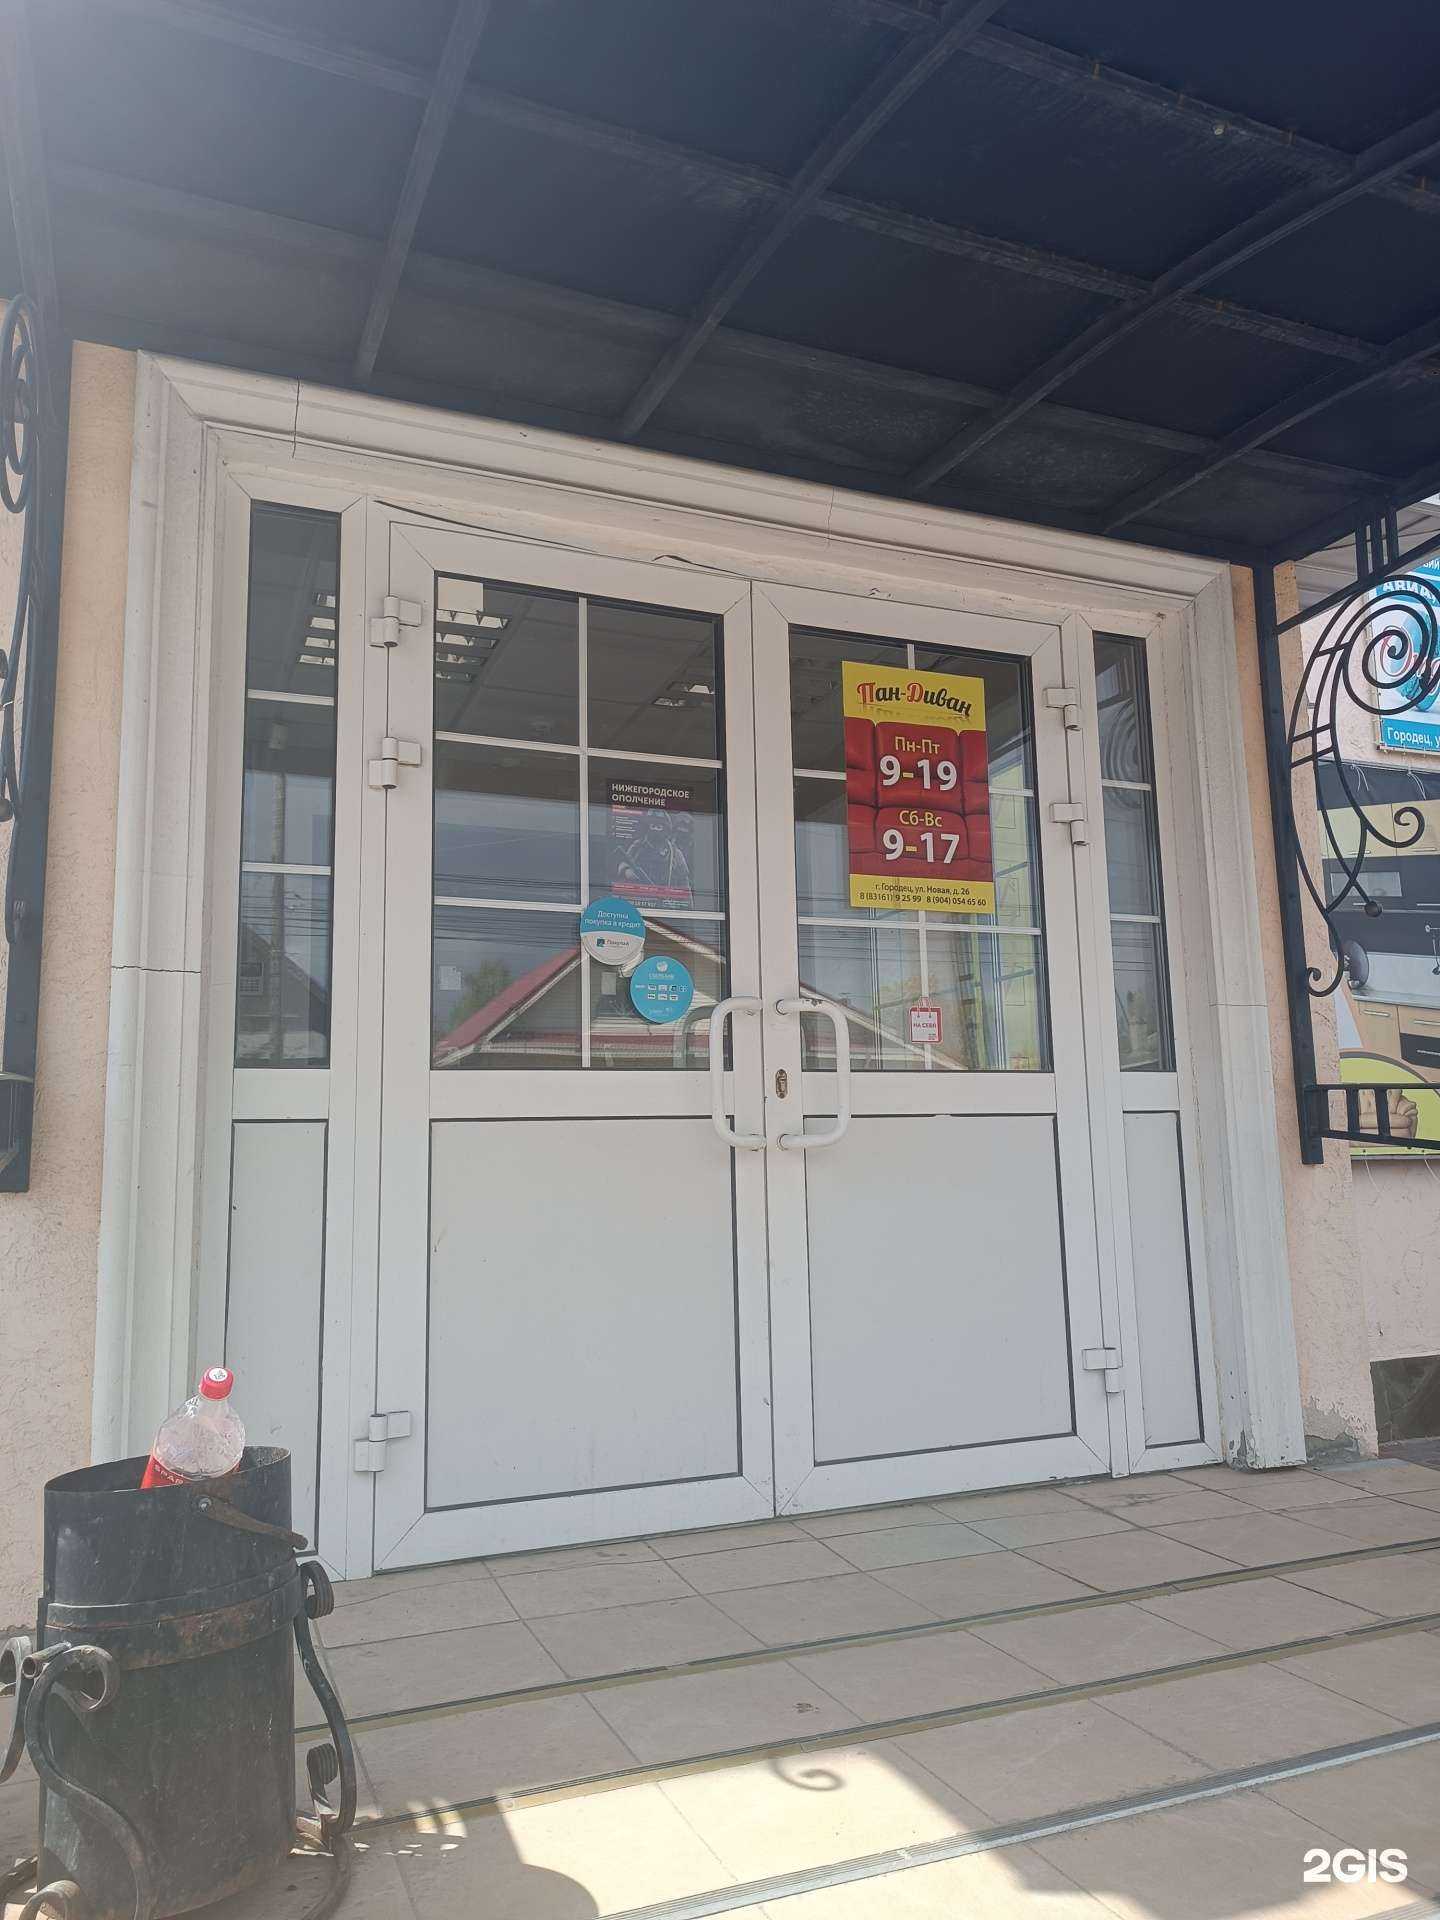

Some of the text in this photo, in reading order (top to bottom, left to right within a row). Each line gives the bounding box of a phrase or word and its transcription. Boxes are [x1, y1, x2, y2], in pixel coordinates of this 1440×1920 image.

[857, 682, 971, 717] Пан-Диван
[895, 736, 940, 754] Пн-Пт
[1387, 727, 1433, 746] Городец,
[880, 755, 957, 790] 9-19
[611, 783, 690, 798] НИЖЕГОРОДСКОЕ
[611, 794, 666, 806] ОПОЛЧЕНИЕ
[899, 810, 942, 827] Сб-Вс
[882, 829, 960, 864] 9-17
[881, 882, 914, 893] Городец,
[926, 886, 952, 896] Новая,
[960, 887, 970, 896] 26
[902, 894, 911, 903] 25
[912, 895, 922, 903] 99
[932, 896, 951, 905] (904)
[977, 898, 987, 906] 60
